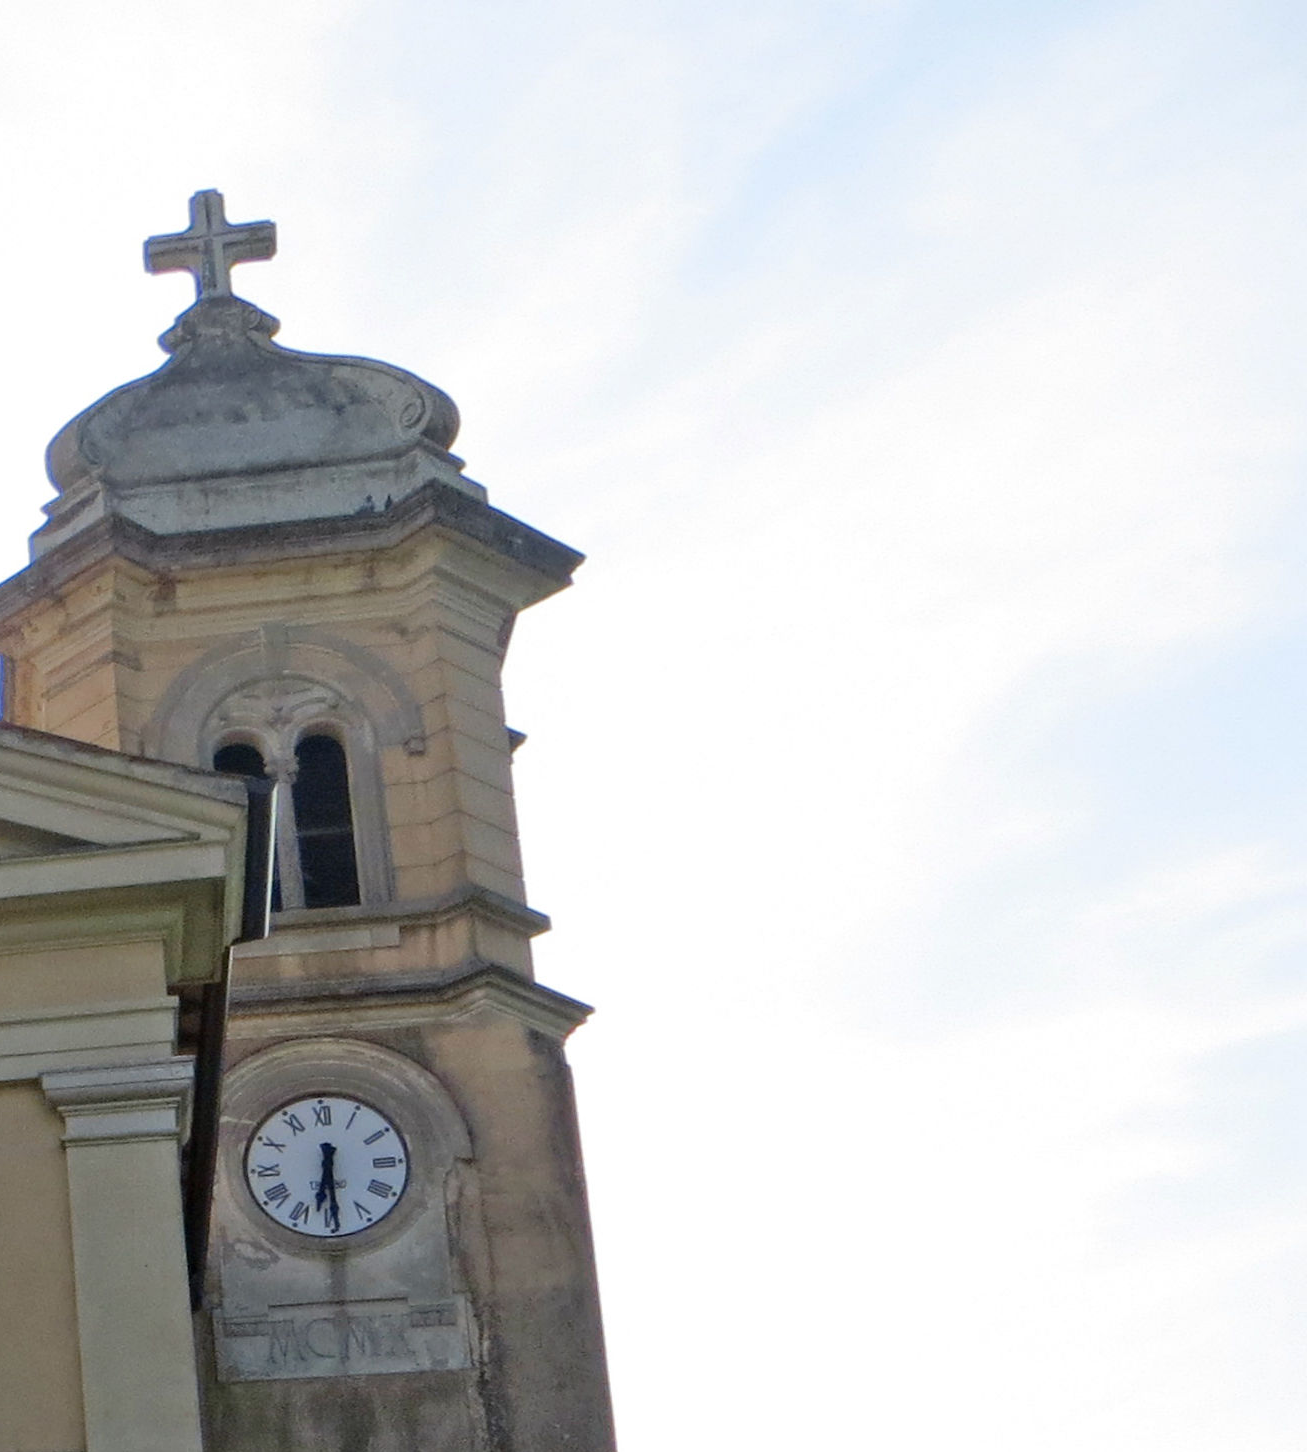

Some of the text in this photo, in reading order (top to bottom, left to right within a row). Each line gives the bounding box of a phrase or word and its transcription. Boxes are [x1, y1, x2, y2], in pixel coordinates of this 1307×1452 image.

[282, 1113, 306, 1137] XI
[312, 1106, 331, 1126] XII
[346, 1111, 357, 1130] I
[263, 1136, 286, 1153] X
[363, 1130, 385, 1145] II
[257, 1163, 280, 1178] IX
[372, 1156, 396, 1169] III
[264, 1182, 292, 1209] VIII
[367, 1179, 393, 1199] IIII
[289, 1201, 310, 1225] VII
[353, 1201, 372, 1220] V
